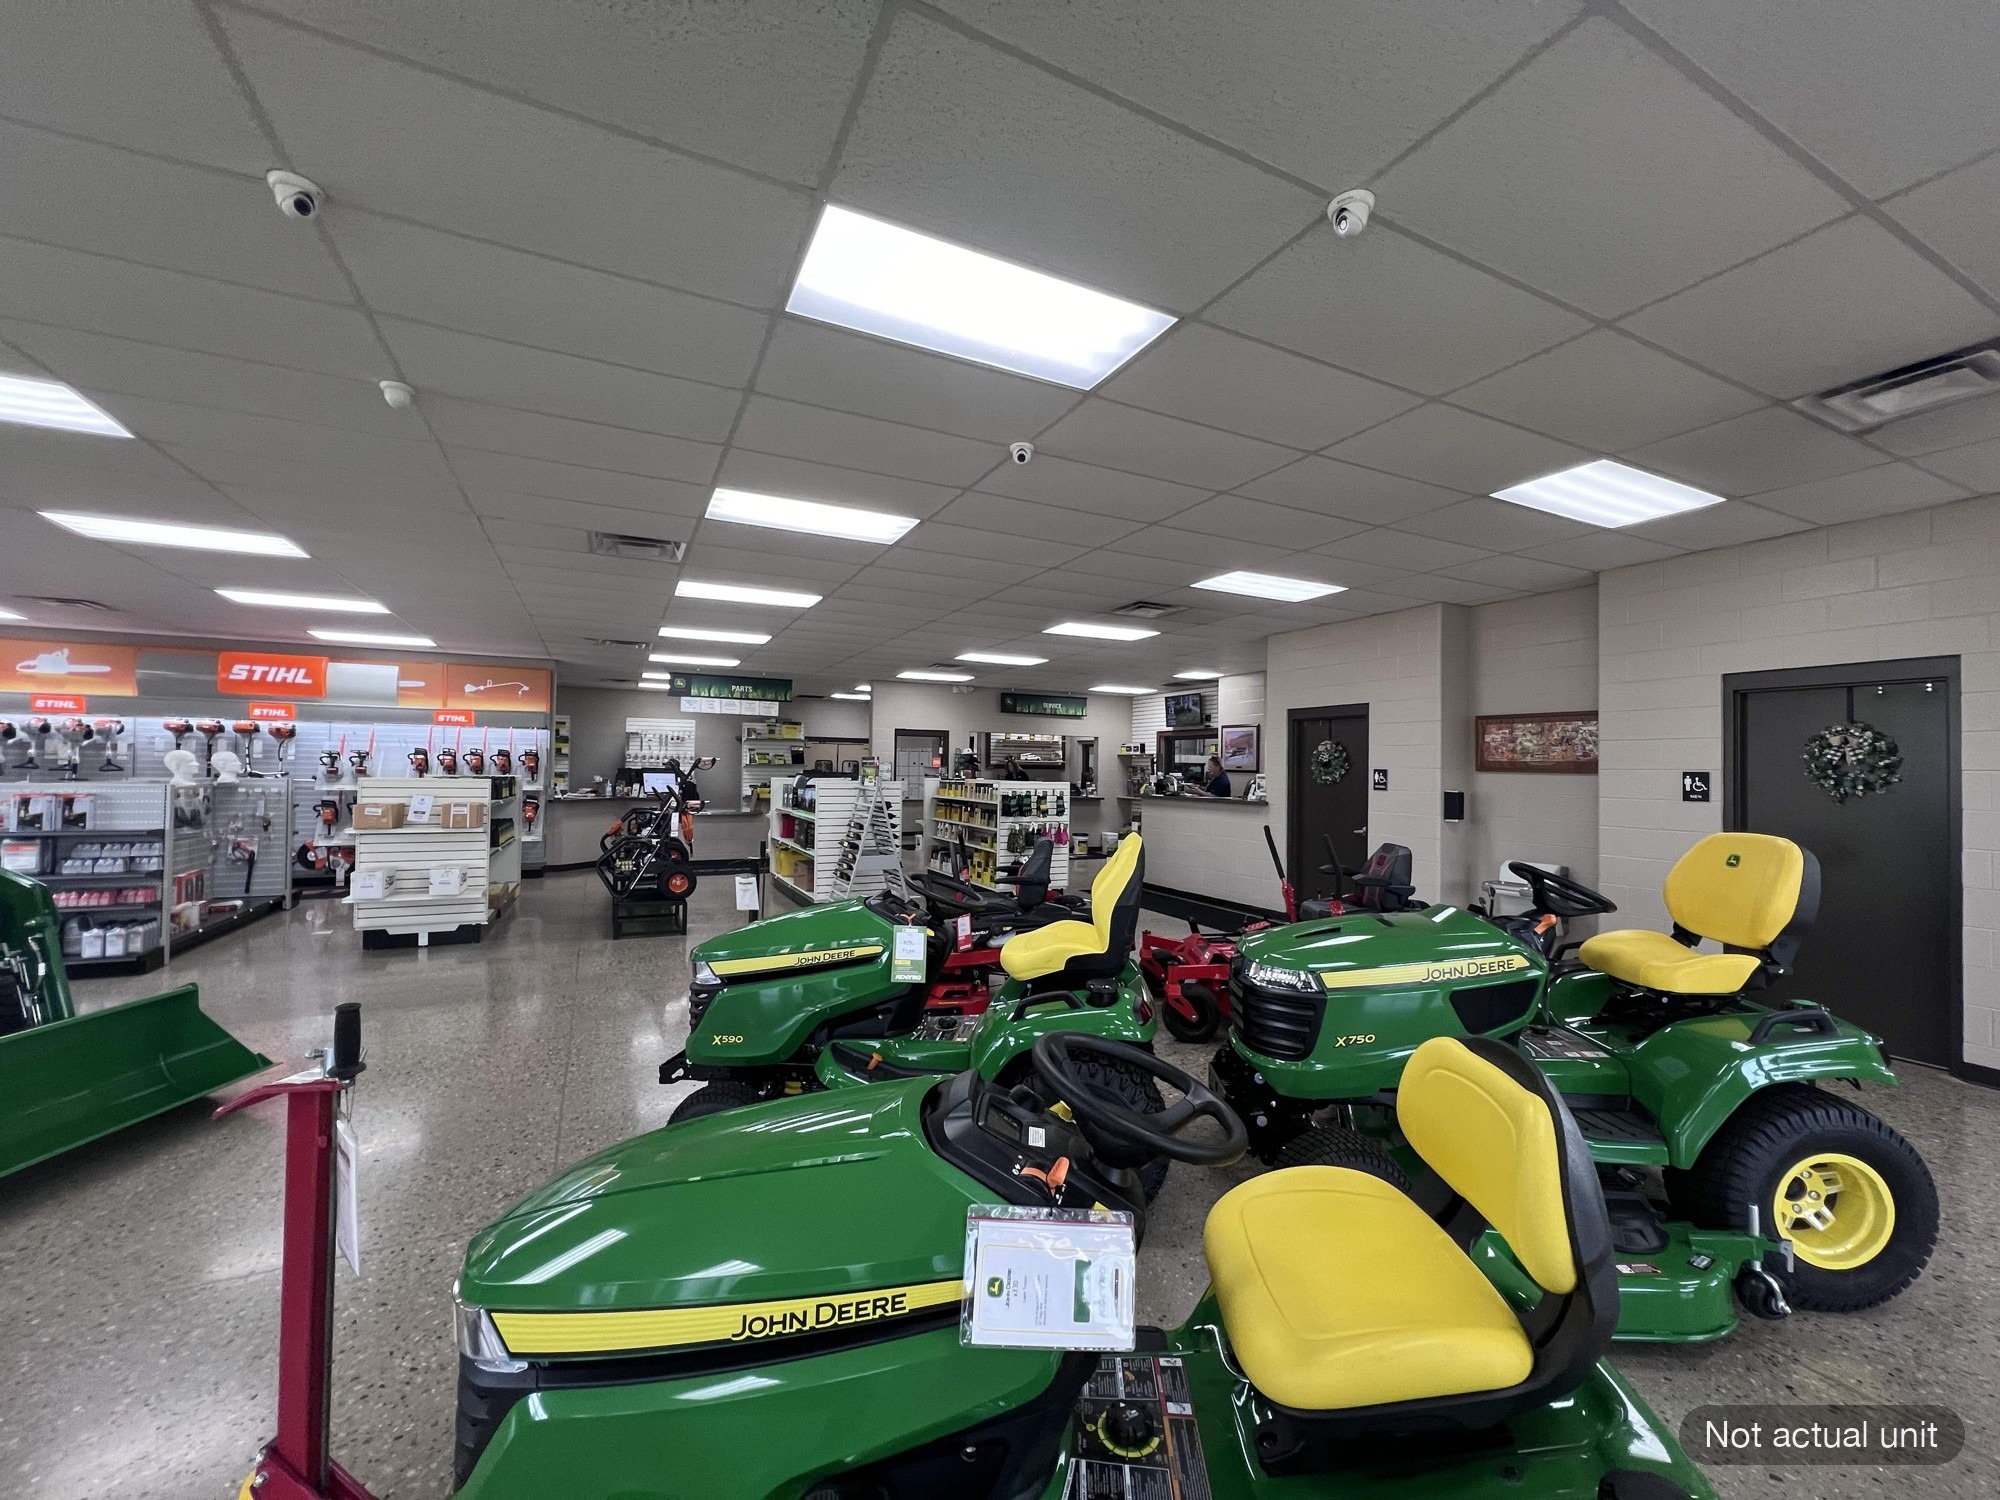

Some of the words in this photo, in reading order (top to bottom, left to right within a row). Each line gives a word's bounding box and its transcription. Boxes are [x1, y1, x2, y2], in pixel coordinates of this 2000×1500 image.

[228, 664, 313, 684] STIHL
[731, 685, 753, 693] PARTS
[34, 699, 79, 709] STIHL
[1042, 702, 1062, 710] SERVICE
[252, 708, 289, 717] STIHL
[437, 714, 469, 723] STIHL
[794, 955, 822, 966] JOHN
[823, 949, 856, 961] DEERE
[1421, 965, 1464, 982] JOHN
[1467, 958, 1516, 975] DEERE
[712, 1034, 744, 1045] X590
[1334, 1034, 1376, 1048] X750
[731, 1309, 808, 1338] JOHN
[814, 1292, 909, 1327] DEERE
